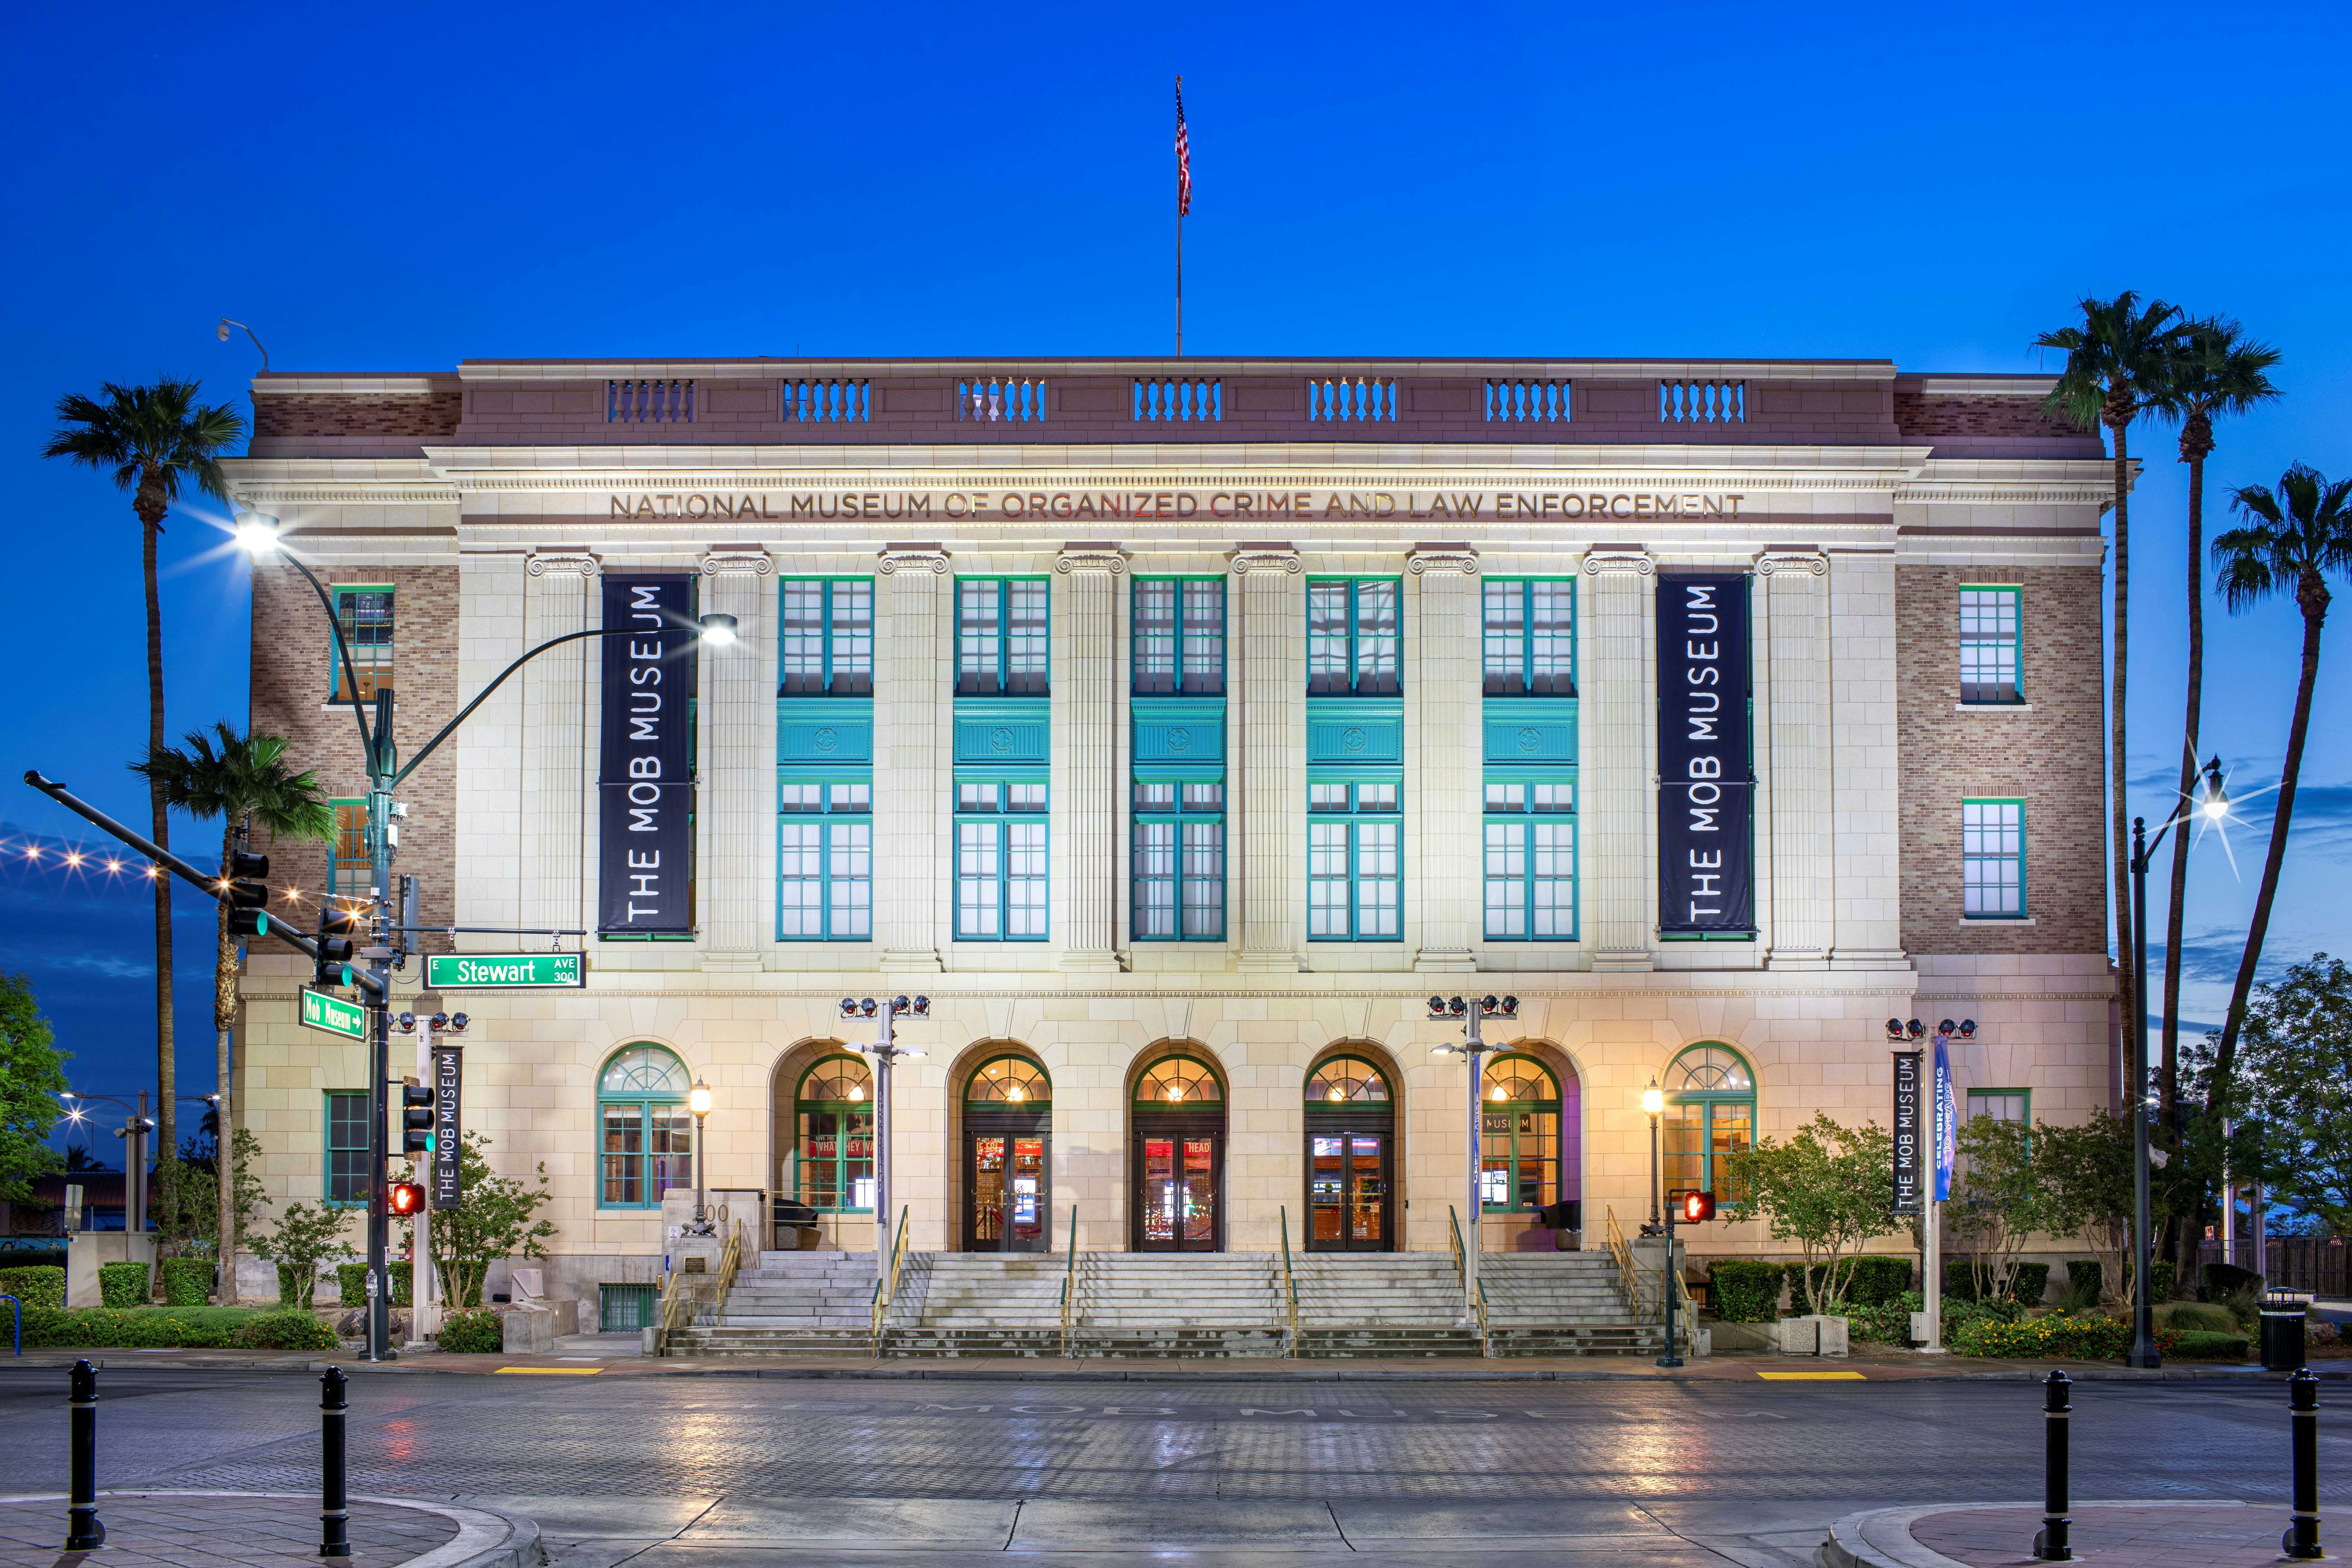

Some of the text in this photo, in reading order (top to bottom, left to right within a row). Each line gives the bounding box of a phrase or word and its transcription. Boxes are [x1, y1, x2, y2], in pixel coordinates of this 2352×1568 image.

[611, 492, 1744, 519] NATIONAL MUSEUM OF ORGANIZED CRIME AND LAW ENFORCEMENT
[627, 586, 662, 922] THE MOB MUSEUM
[1686, 586, 1722, 922] THE MOB MUSEUM
[432, 959, 575, 982] E Stewart AVE
[554, 972, 575, 982] 300
[306, 995, 351, 1030] Mob Museum
[1944, 1082, 1953, 1133] YEARS
[440, 1054, 456, 1200] THE MOB MUSEUM
[1898, 1058, 1914, 1208] THE MOB MUSEUM
[846, 1142, 860, 1152] HEY
[1943, 1136, 1951, 1154] 10
